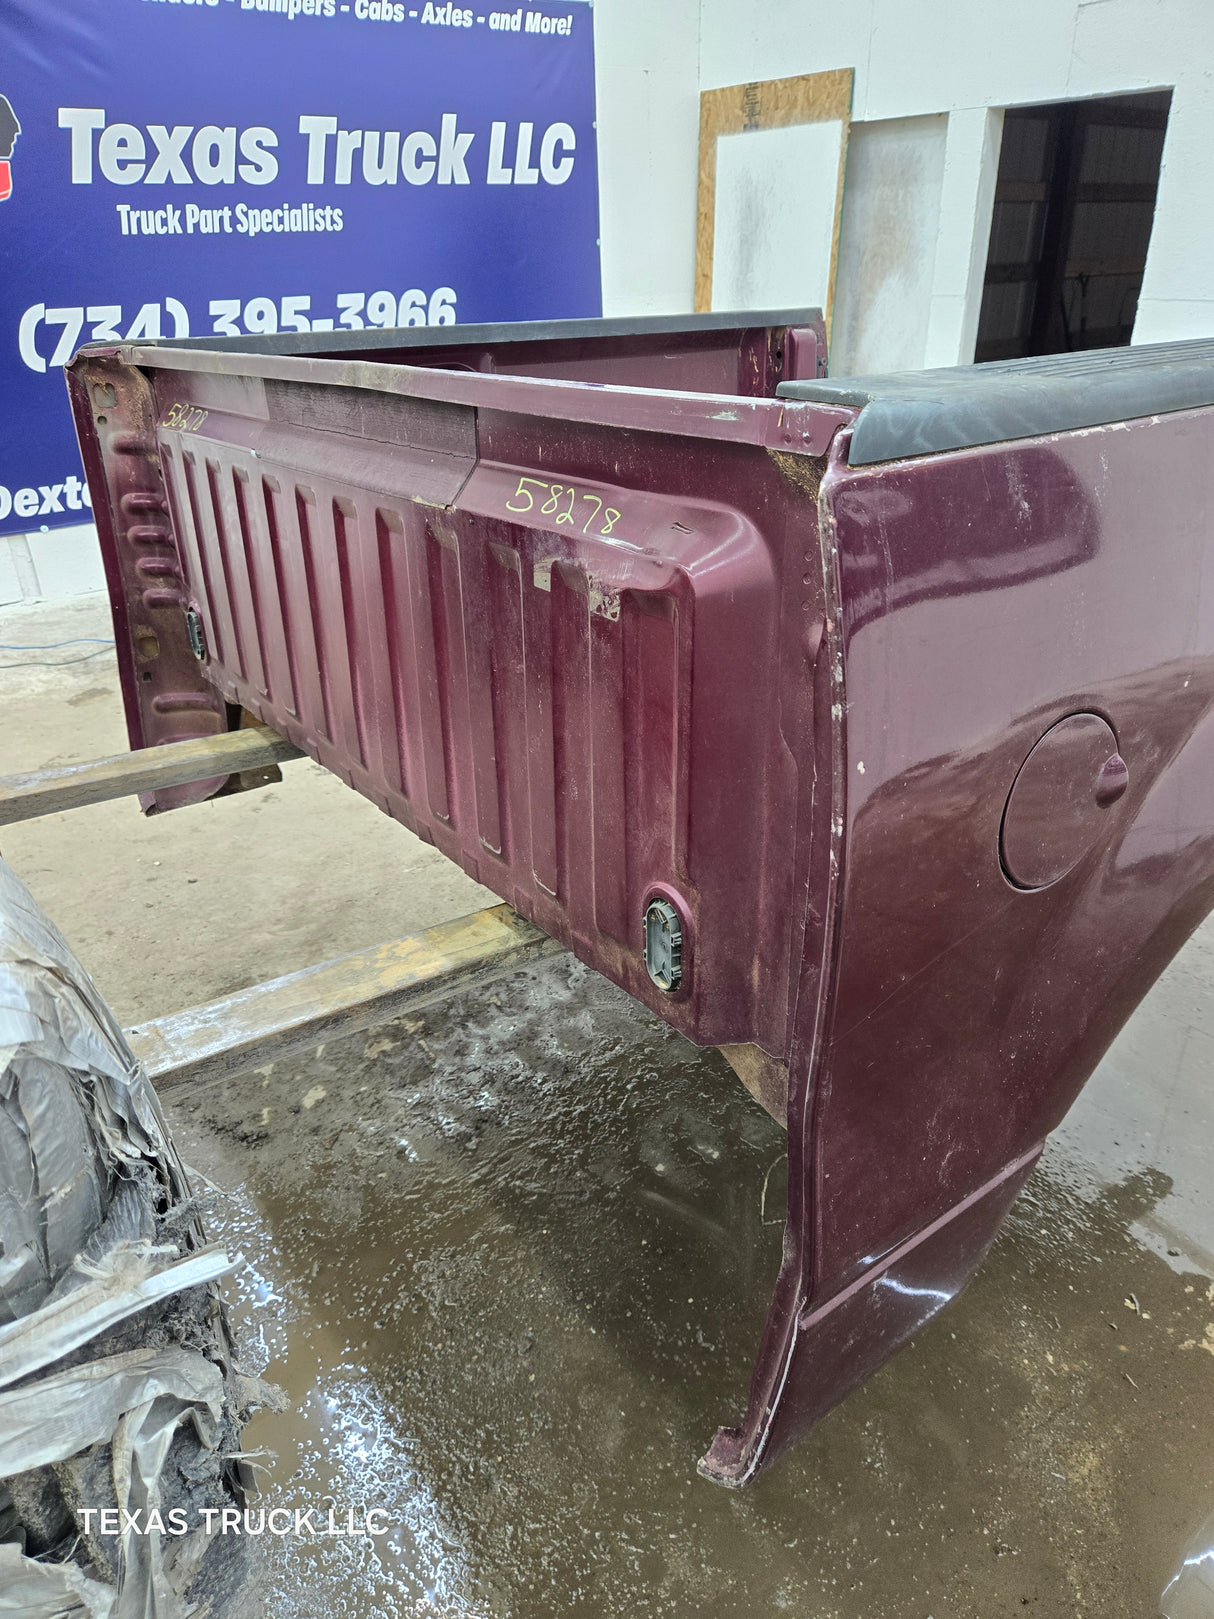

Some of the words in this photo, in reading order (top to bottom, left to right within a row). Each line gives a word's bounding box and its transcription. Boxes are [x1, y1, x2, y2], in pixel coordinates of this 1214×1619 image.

[354, 0, 405, 22] Cabs
[421, 2, 473, 28] Axles
[489, 9, 523, 32] and
[525, 12, 573, 35] More!
[58, 107, 279, 186] Texas
[298, 113, 475, 186] Truck
[486, 121, 576, 186] LLC
[117, 204, 182, 236] Truck
[186, 204, 232, 235] Part
[236, 203, 343, 237] Specialists
[19, 297, 190, 373] (734)
[209, 287, 457, 337] 395-3966
[505, 477, 622, 534] 58278
